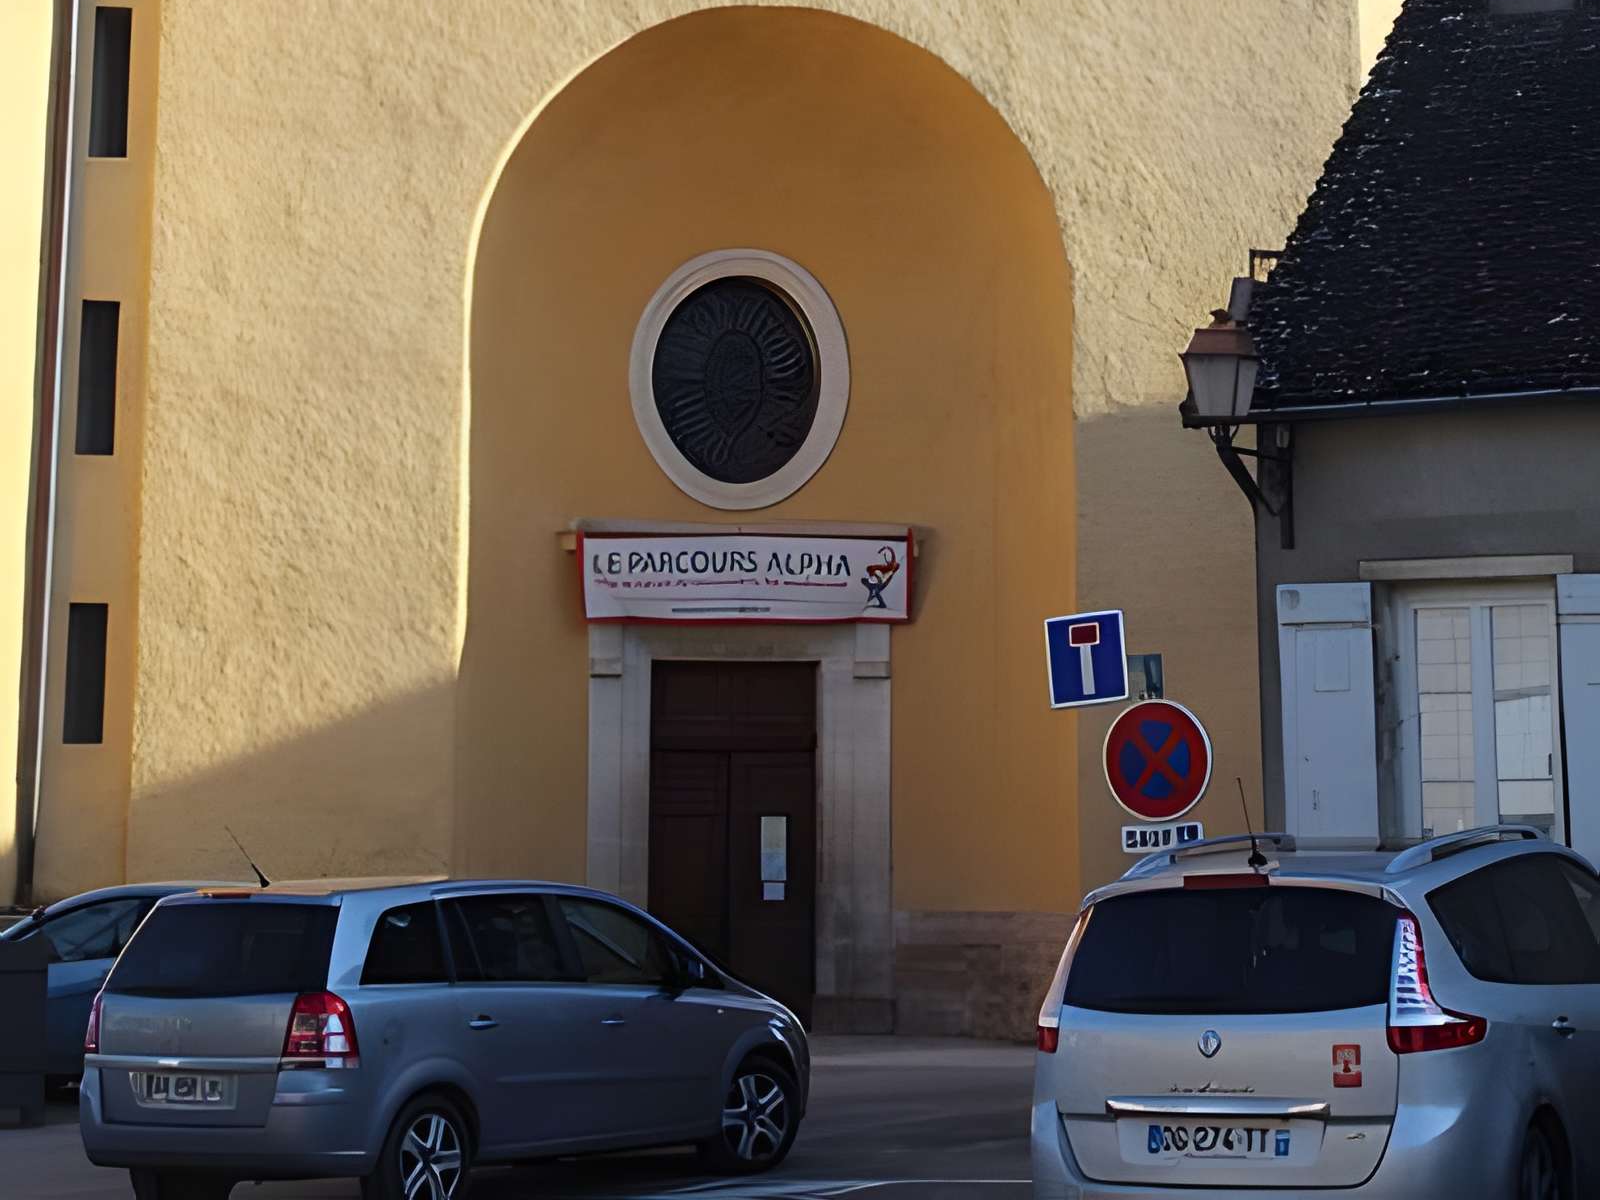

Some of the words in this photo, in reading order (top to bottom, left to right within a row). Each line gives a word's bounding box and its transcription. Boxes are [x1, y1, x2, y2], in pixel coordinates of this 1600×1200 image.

[593, 552, 622, 575] LE
[628, 551, 758, 574] PARCOURS
[767, 552, 851, 576] ALPHA
